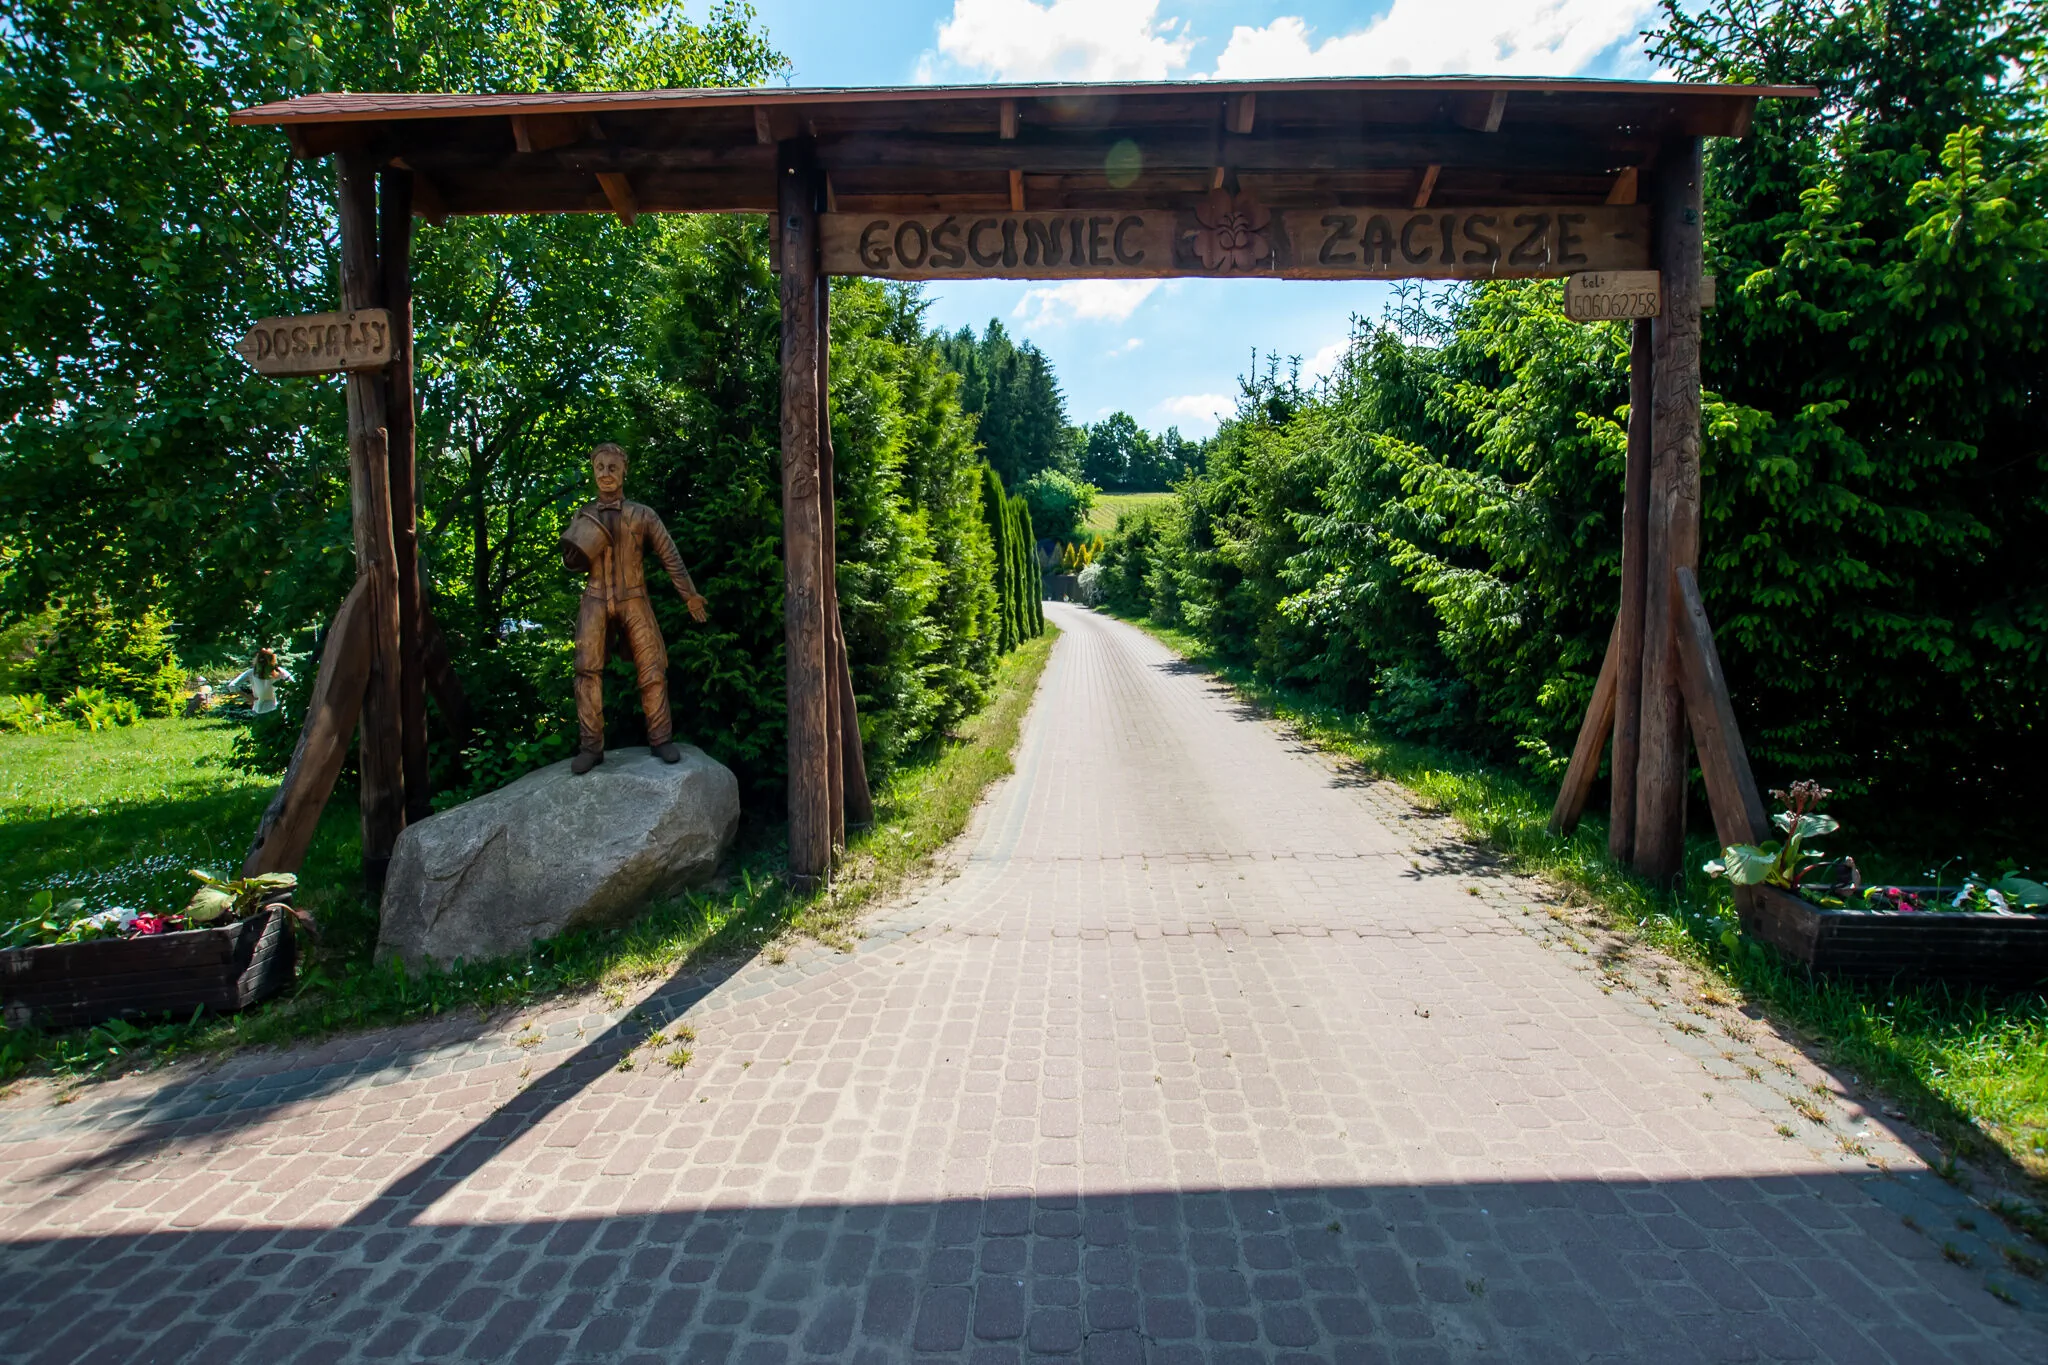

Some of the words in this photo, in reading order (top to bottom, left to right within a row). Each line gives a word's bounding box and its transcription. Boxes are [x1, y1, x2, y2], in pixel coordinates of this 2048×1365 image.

[860, 215, 1145, 270] GOŚCINIEC
[1318, 213, 1589, 266] ZACISZE
[1580, 275, 1605, 289] tel:
[1574, 292, 1657, 318] 506062258
